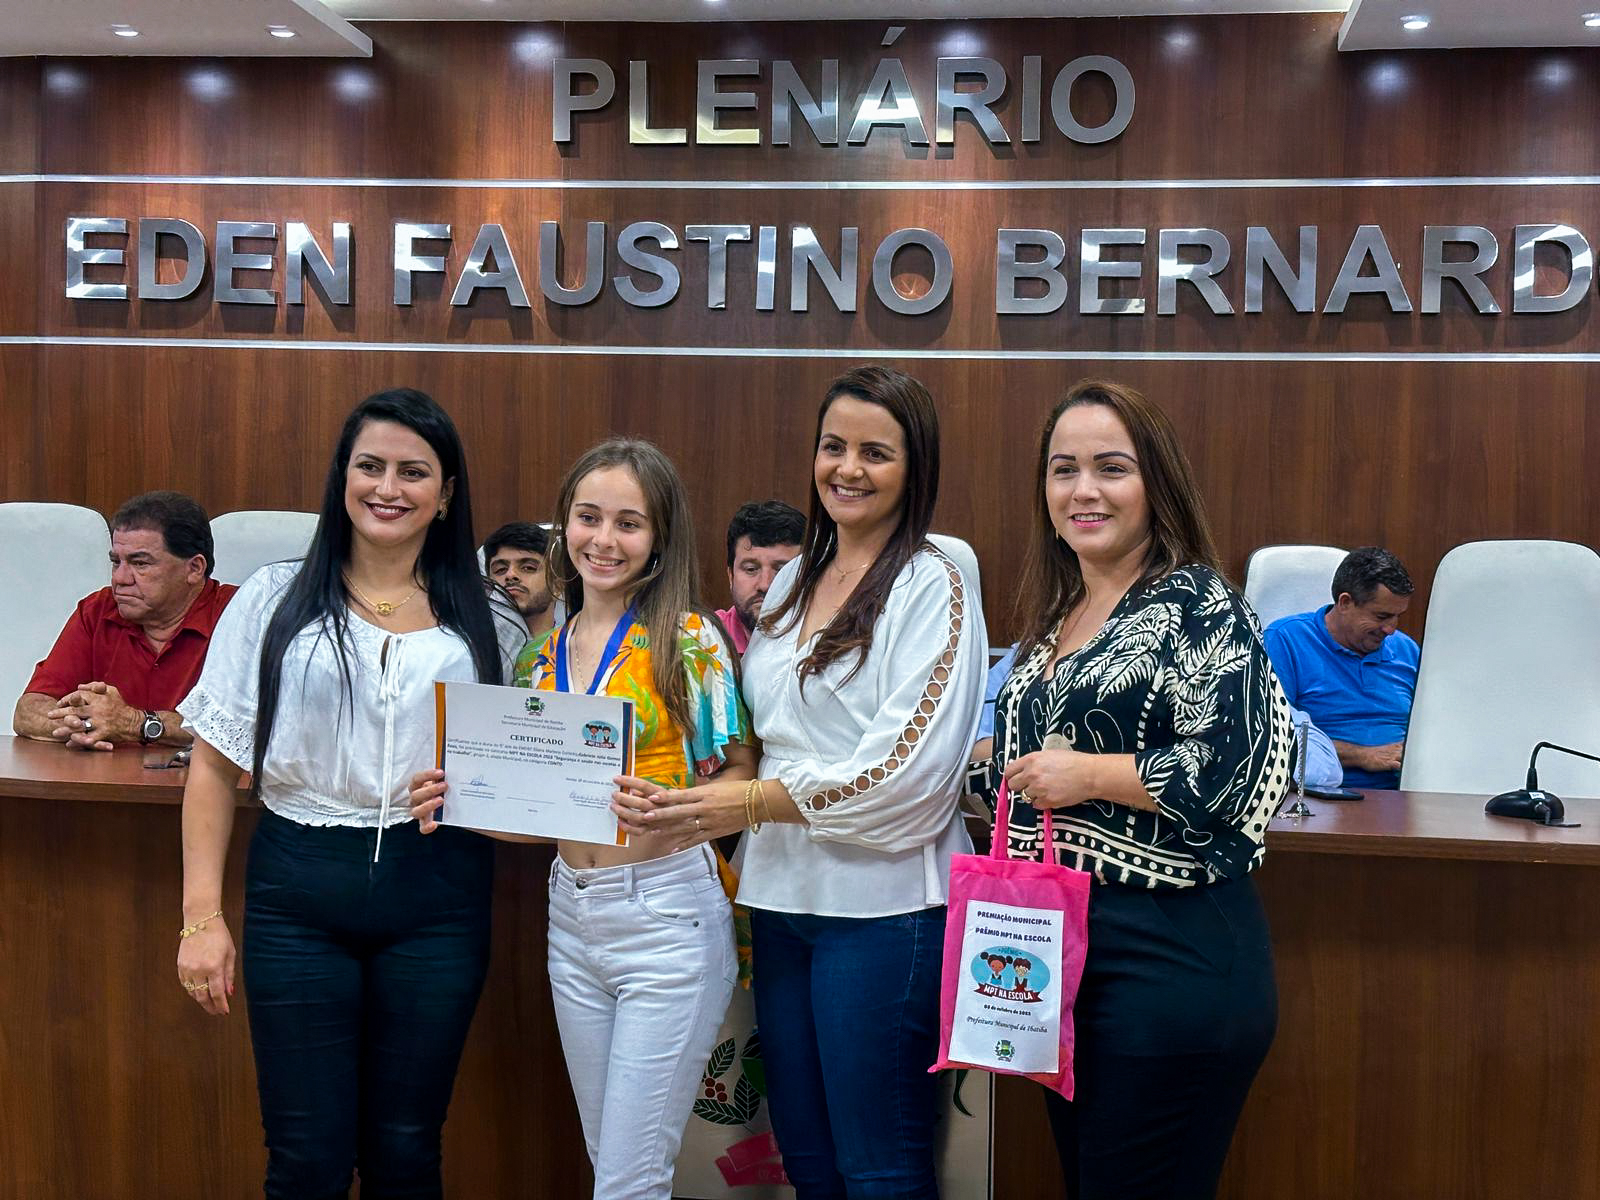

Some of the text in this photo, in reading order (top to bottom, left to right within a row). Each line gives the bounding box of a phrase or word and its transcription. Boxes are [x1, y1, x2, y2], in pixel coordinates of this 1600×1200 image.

[552, 26, 1136, 146] PLENÁRIO
[66, 217, 1600, 315] EDEN FAUSTINO BERNARD
[510, 734, 564, 746] CERTIFICADO
[977, 911, 1052, 926] PREMIAÇÃO MUNICIPAL
[975, 926, 1052, 943] PRÊMIO MPT NA ESCOLA
[983, 984, 1033, 1000] MPT NA ESCOLA
[967, 1015, 994, 1026] Prefeitura
[994, 1018, 1019, 1031] Municipal
